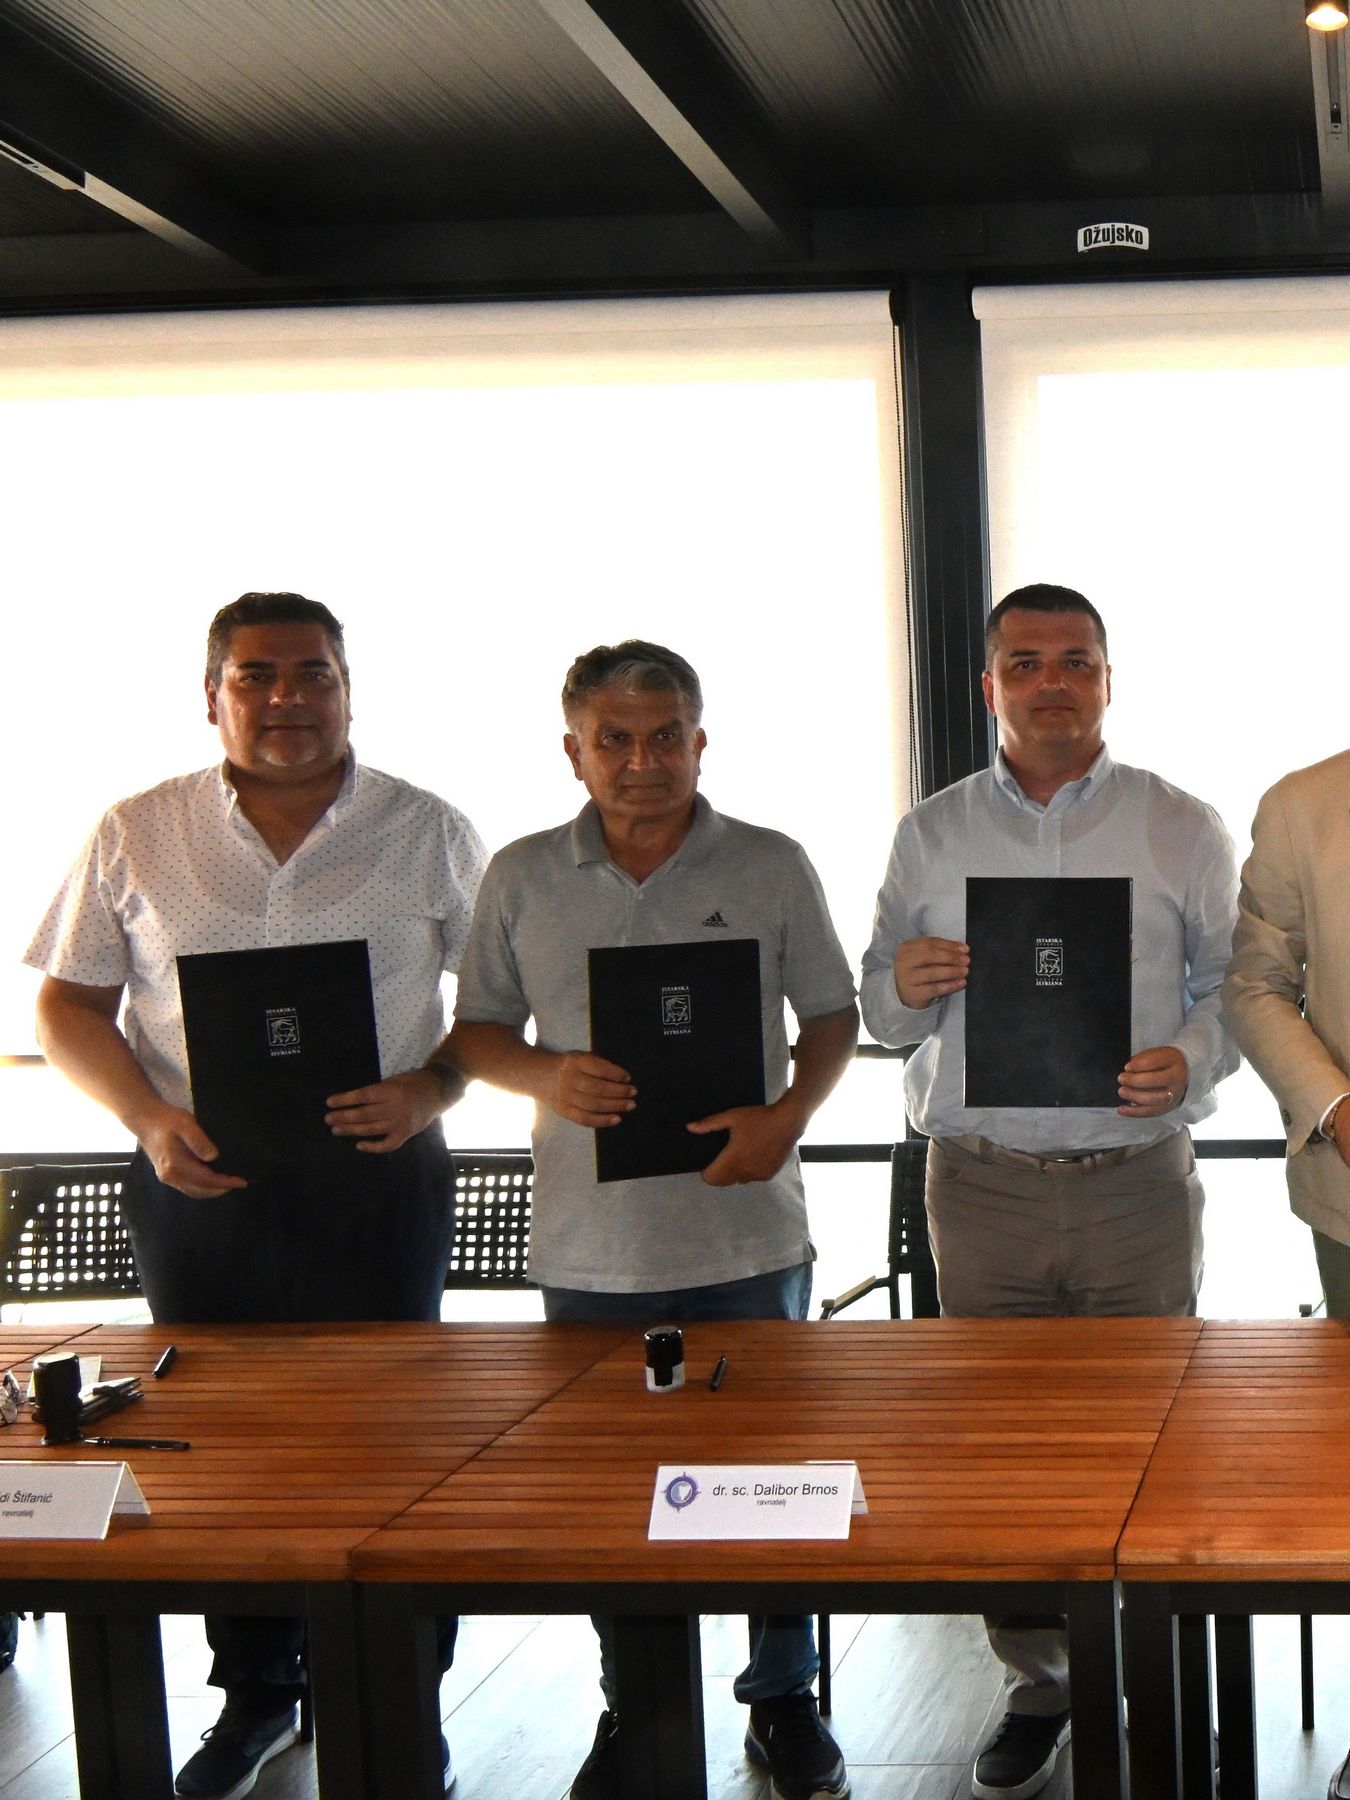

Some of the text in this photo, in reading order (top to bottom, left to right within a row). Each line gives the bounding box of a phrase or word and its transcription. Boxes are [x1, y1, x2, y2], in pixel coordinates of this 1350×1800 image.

[1083, 224, 1144, 247] Ožujsko
[712, 1484, 839, 1496] dr. sc. Dalibor Brnos
[12, 1490, 53, 1503] Štifanić
[756, 1499, 787, 1507] ravnatelj
